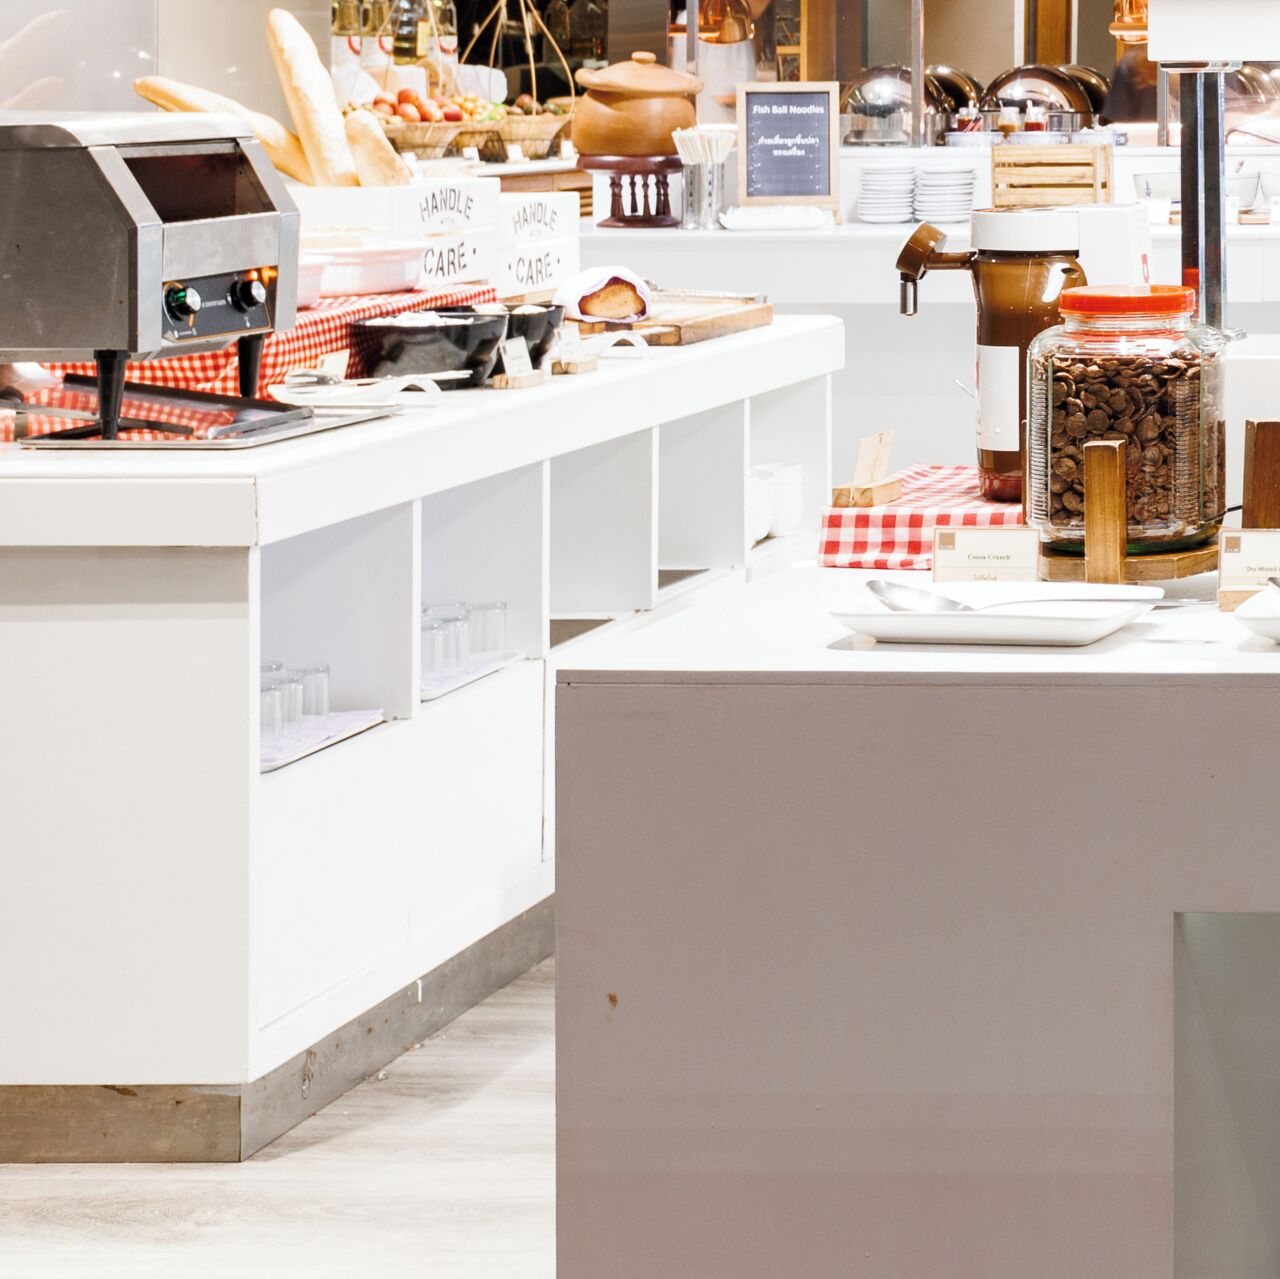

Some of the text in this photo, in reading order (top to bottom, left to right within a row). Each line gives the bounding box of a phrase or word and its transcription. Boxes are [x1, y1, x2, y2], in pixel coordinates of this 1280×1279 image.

[752, 104, 825, 114] Fish Ball Noodles
[419, 187, 474, 222] HANDLE
[512, 202, 557, 235] HANDLE
[423, 241, 467, 278] CARE
[516, 252, 553, 286] CARE
